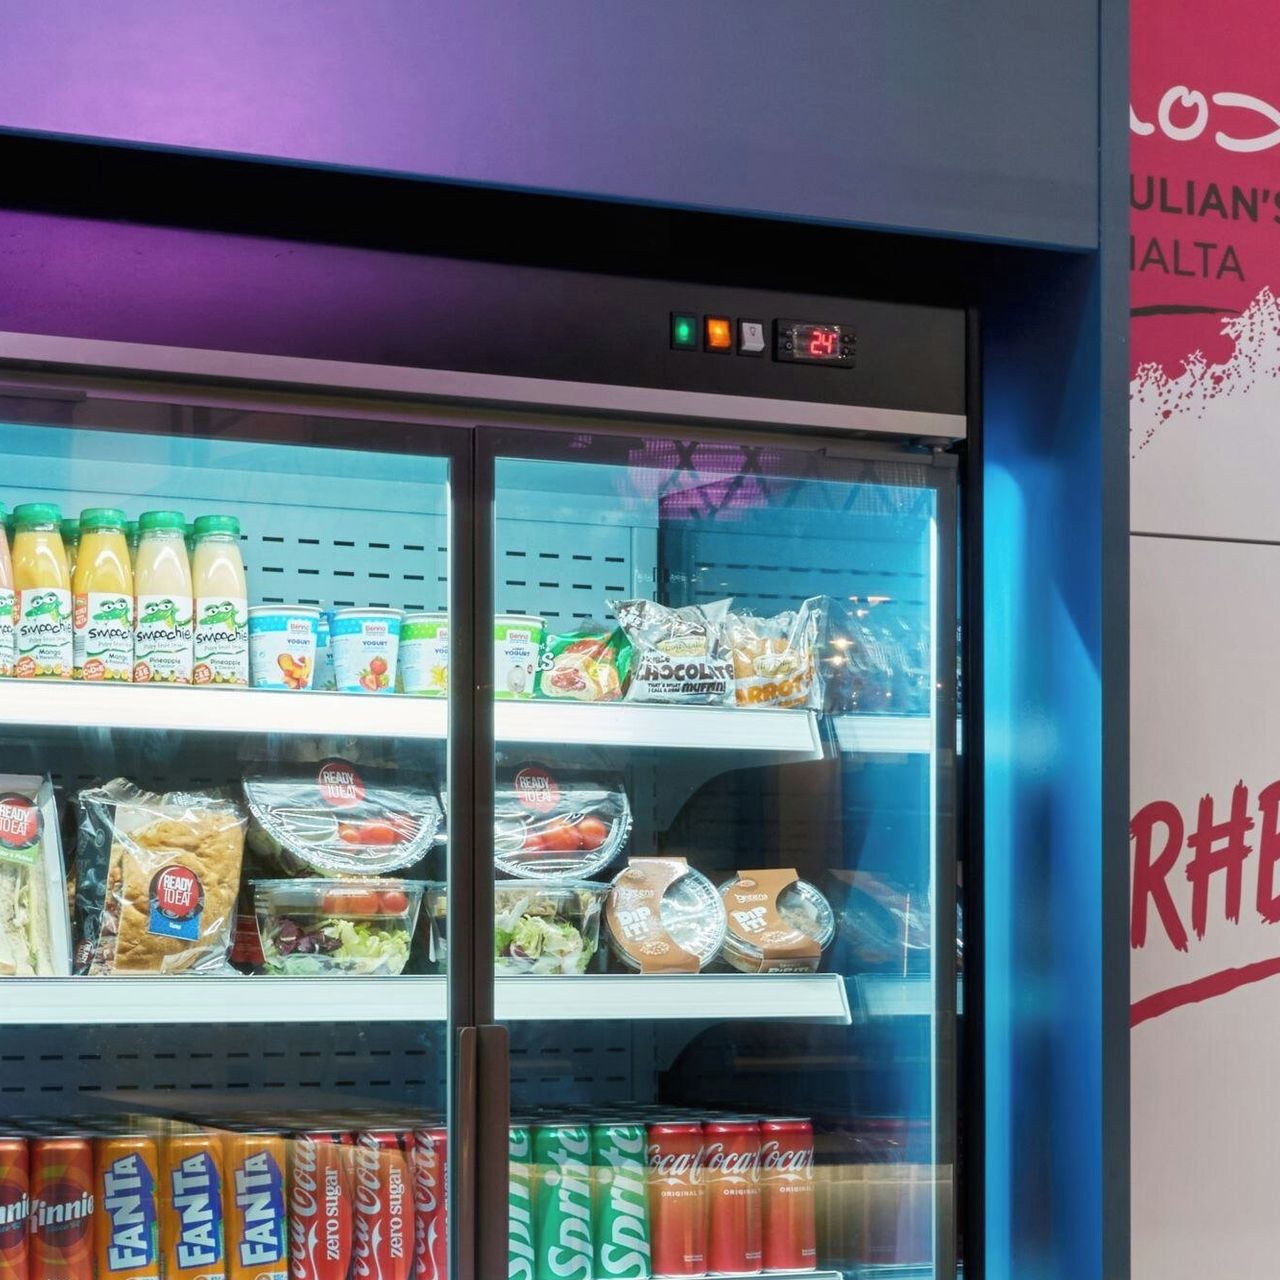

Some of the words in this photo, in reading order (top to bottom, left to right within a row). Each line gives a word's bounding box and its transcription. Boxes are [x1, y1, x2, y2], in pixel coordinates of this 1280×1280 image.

[1130, 236, 1246, 282] ALTA
[323, 771, 355, 785] READY
[519, 776, 549, 788] READY
[0, 804, 30, 819] READY
[163, 874, 193, 892] READY
[104, 1155, 148, 1270] FANTA
[172, 1153, 216, 1268] FANTA
[235, 1152, 278, 1266] FANTA
[325, 1166, 342, 1217] sugar
[389, 1164, 405, 1215] sugar
[548, 1126, 594, 1280] Sprite
[601, 1124, 651, 1279] Sprite
[326, 1219, 340, 1261] zero
[390, 1217, 404, 1259] zero
